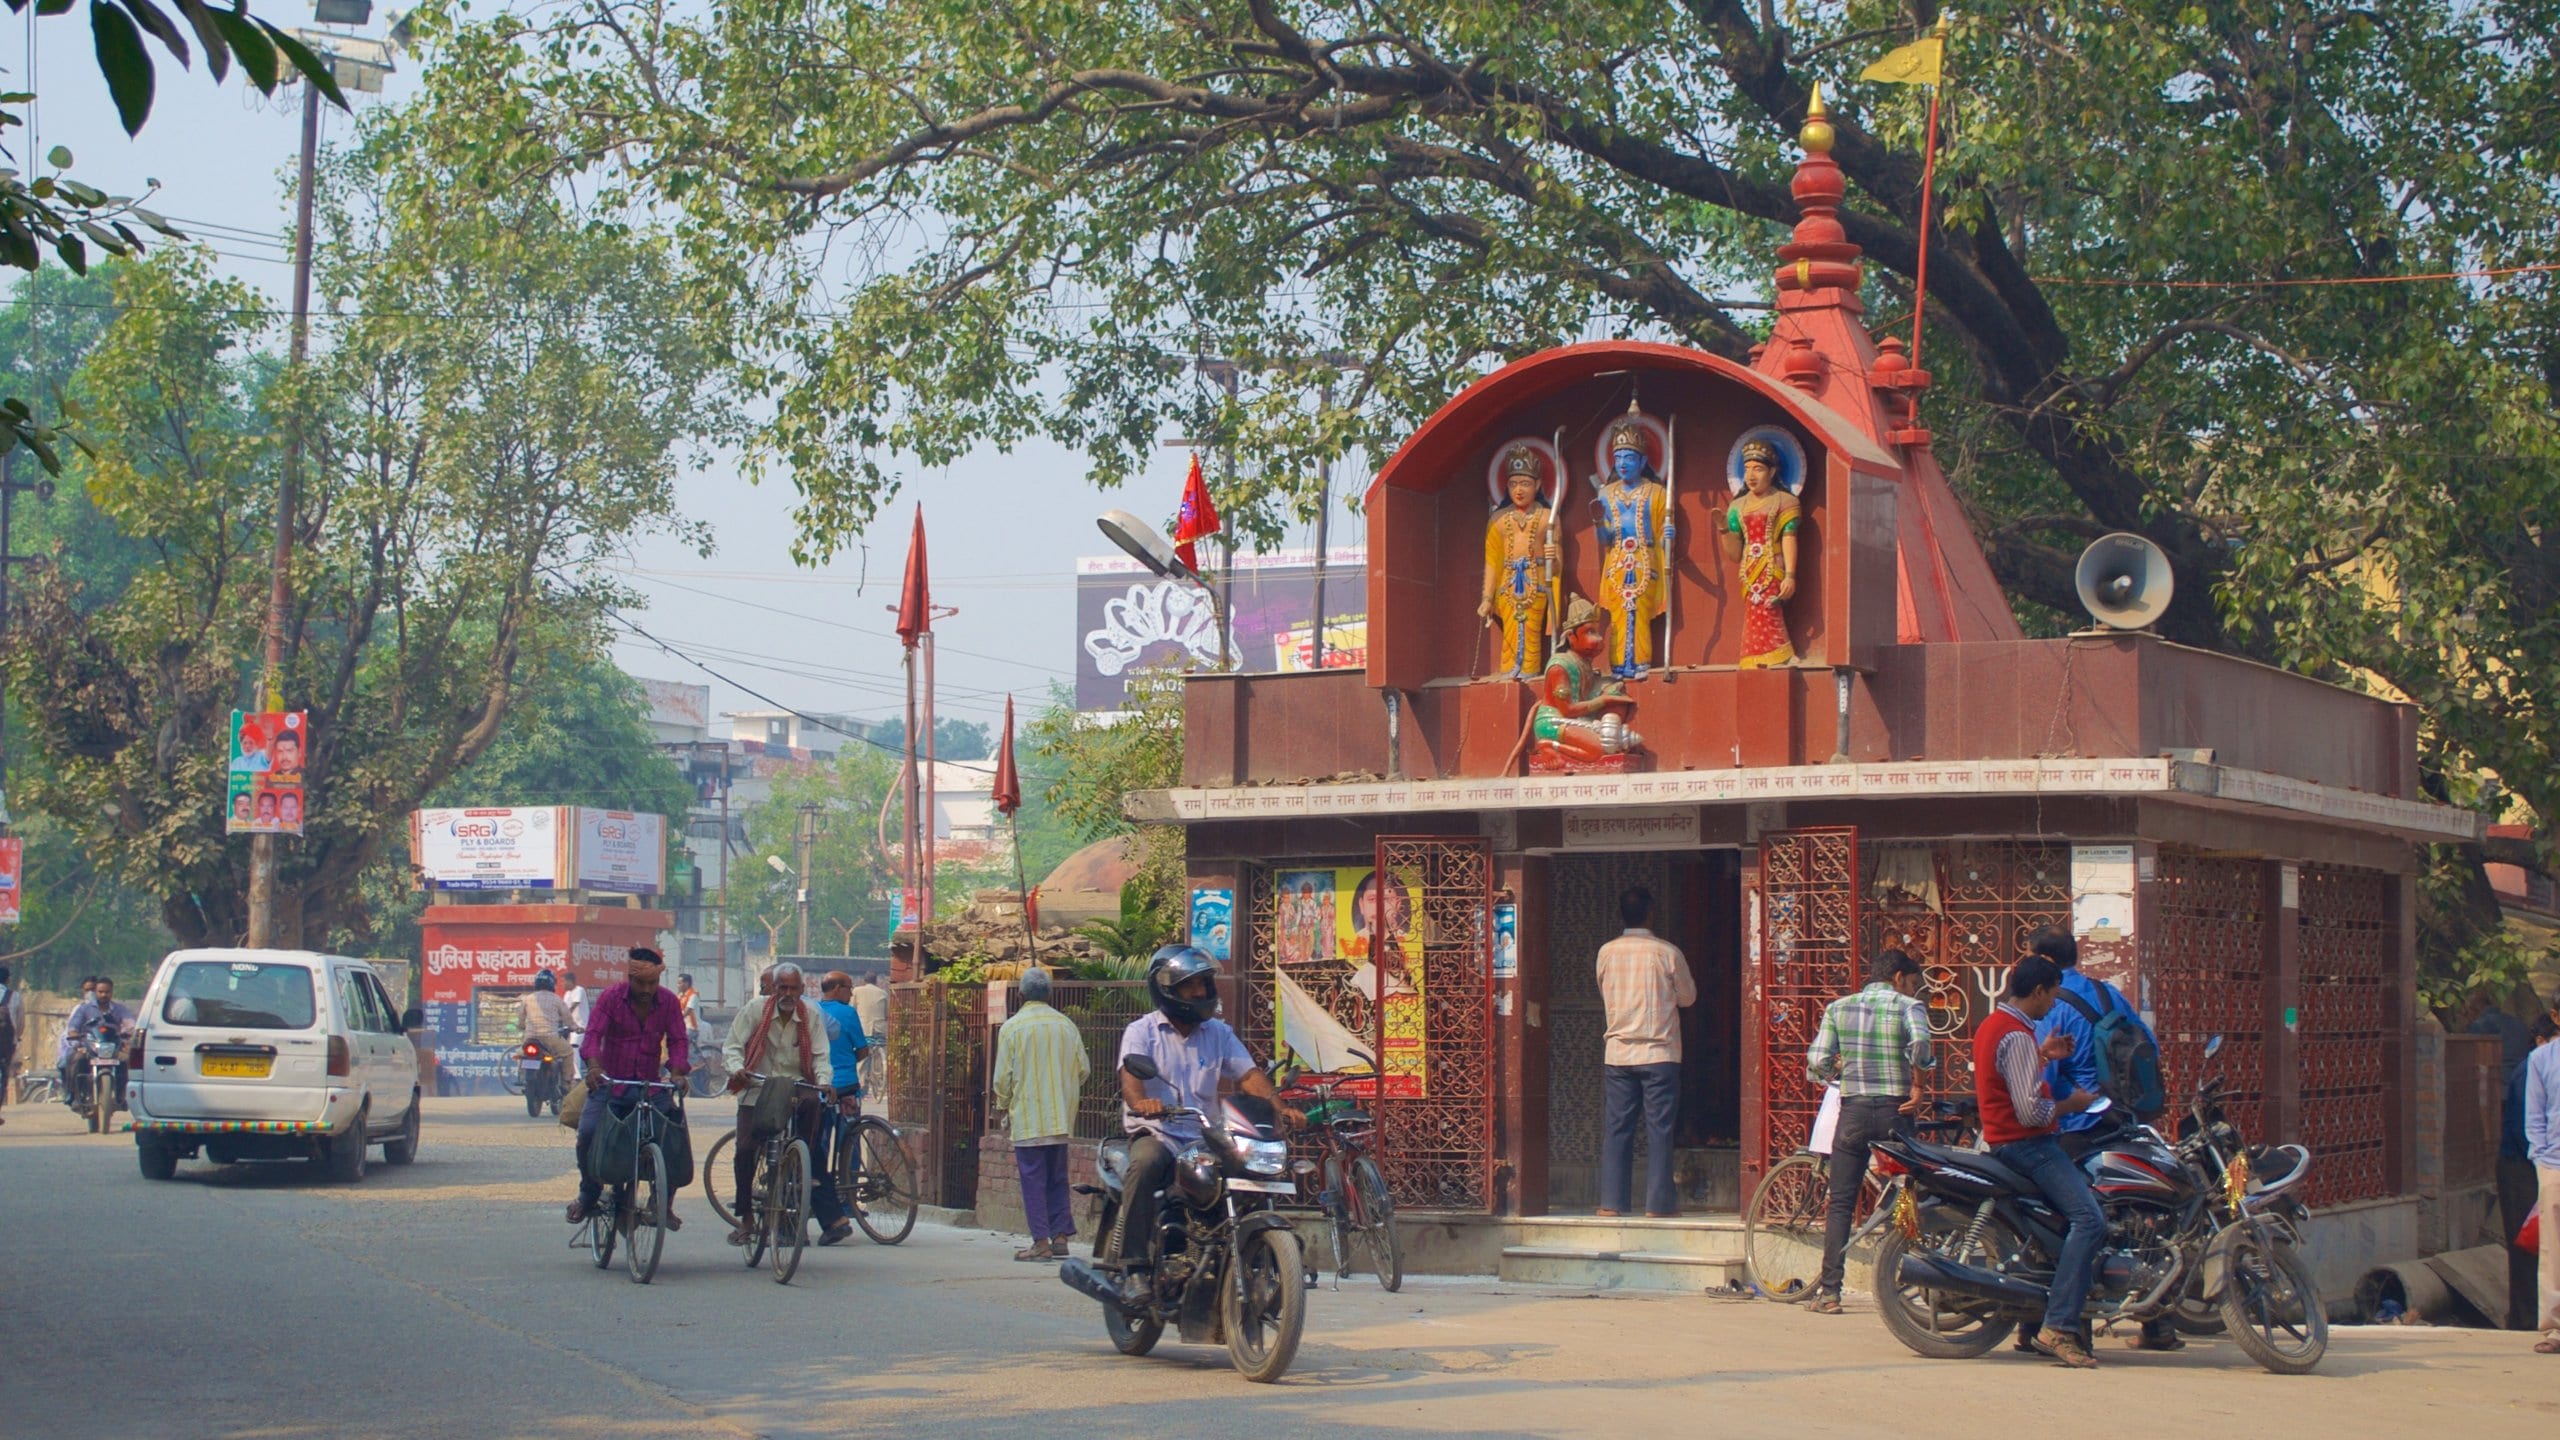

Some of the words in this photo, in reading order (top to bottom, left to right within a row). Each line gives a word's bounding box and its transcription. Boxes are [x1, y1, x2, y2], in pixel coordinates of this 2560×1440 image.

[1184, 800, 1200, 811] राम
[1210, 798, 1229, 808] राम
[1236, 798, 1255, 808] राम
[1261, 796, 1280, 808] राम
[1285, 796, 1304, 807] राम
[1312, 795, 1331, 806] राम
[1337, 794, 1356, 805] राम
[1361, 793, 1380, 804] राम
[1416, 791, 1434, 802] राम
[1442, 790, 1460, 802] राम
[1467, 789, 1488, 800] राम
[1493, 788, 1514, 800] राम
[1524, 787, 1542, 798] राम
[1550, 786, 1568, 798] राम
[1573, 786, 1592, 798] राम
[1600, 784, 1620, 796] राम
[1632, 783, 1653, 794] राम
[1660, 782, 1679, 793] राम
[1687, 781, 1707, 792] राम
[1714, 780, 1736, 791] राम
[1749, 778, 1768, 789] राम
[1775, 776, 1795, 788] राम
[1801, 776, 1822, 788] राम
[1828, 775, 1850, 786] राम
[1863, 774, 1882, 786] राम
[1888, 773, 1909, 785] राम
[1916, 772, 1940, 784] राम
[1947, 772, 1972, 783] राम
[1984, 771, 2008, 782] राम
[2013, 770, 2034, 782] राम
[2042, 770, 2063, 782] राम
[2070, 770, 2096, 781] राम
[2110, 768, 2132, 780] राम
[2137, 768, 2160, 780] राम
[458, 823, 491, 837] SRG
[601, 825, 622, 840] SRG
[1628, 817, 1661, 836] हनुमान
[461, 838, 474, 846] PLY
[484, 838, 516, 846] BOARDS
[428, 944, 473, 975] पुलिस
[476, 949, 531, 971] सहायता
[535, 942, 568, 971] केन्द्र
[572, 938, 600, 966] पुलिस
[601, 944, 631, 965] सहाय
